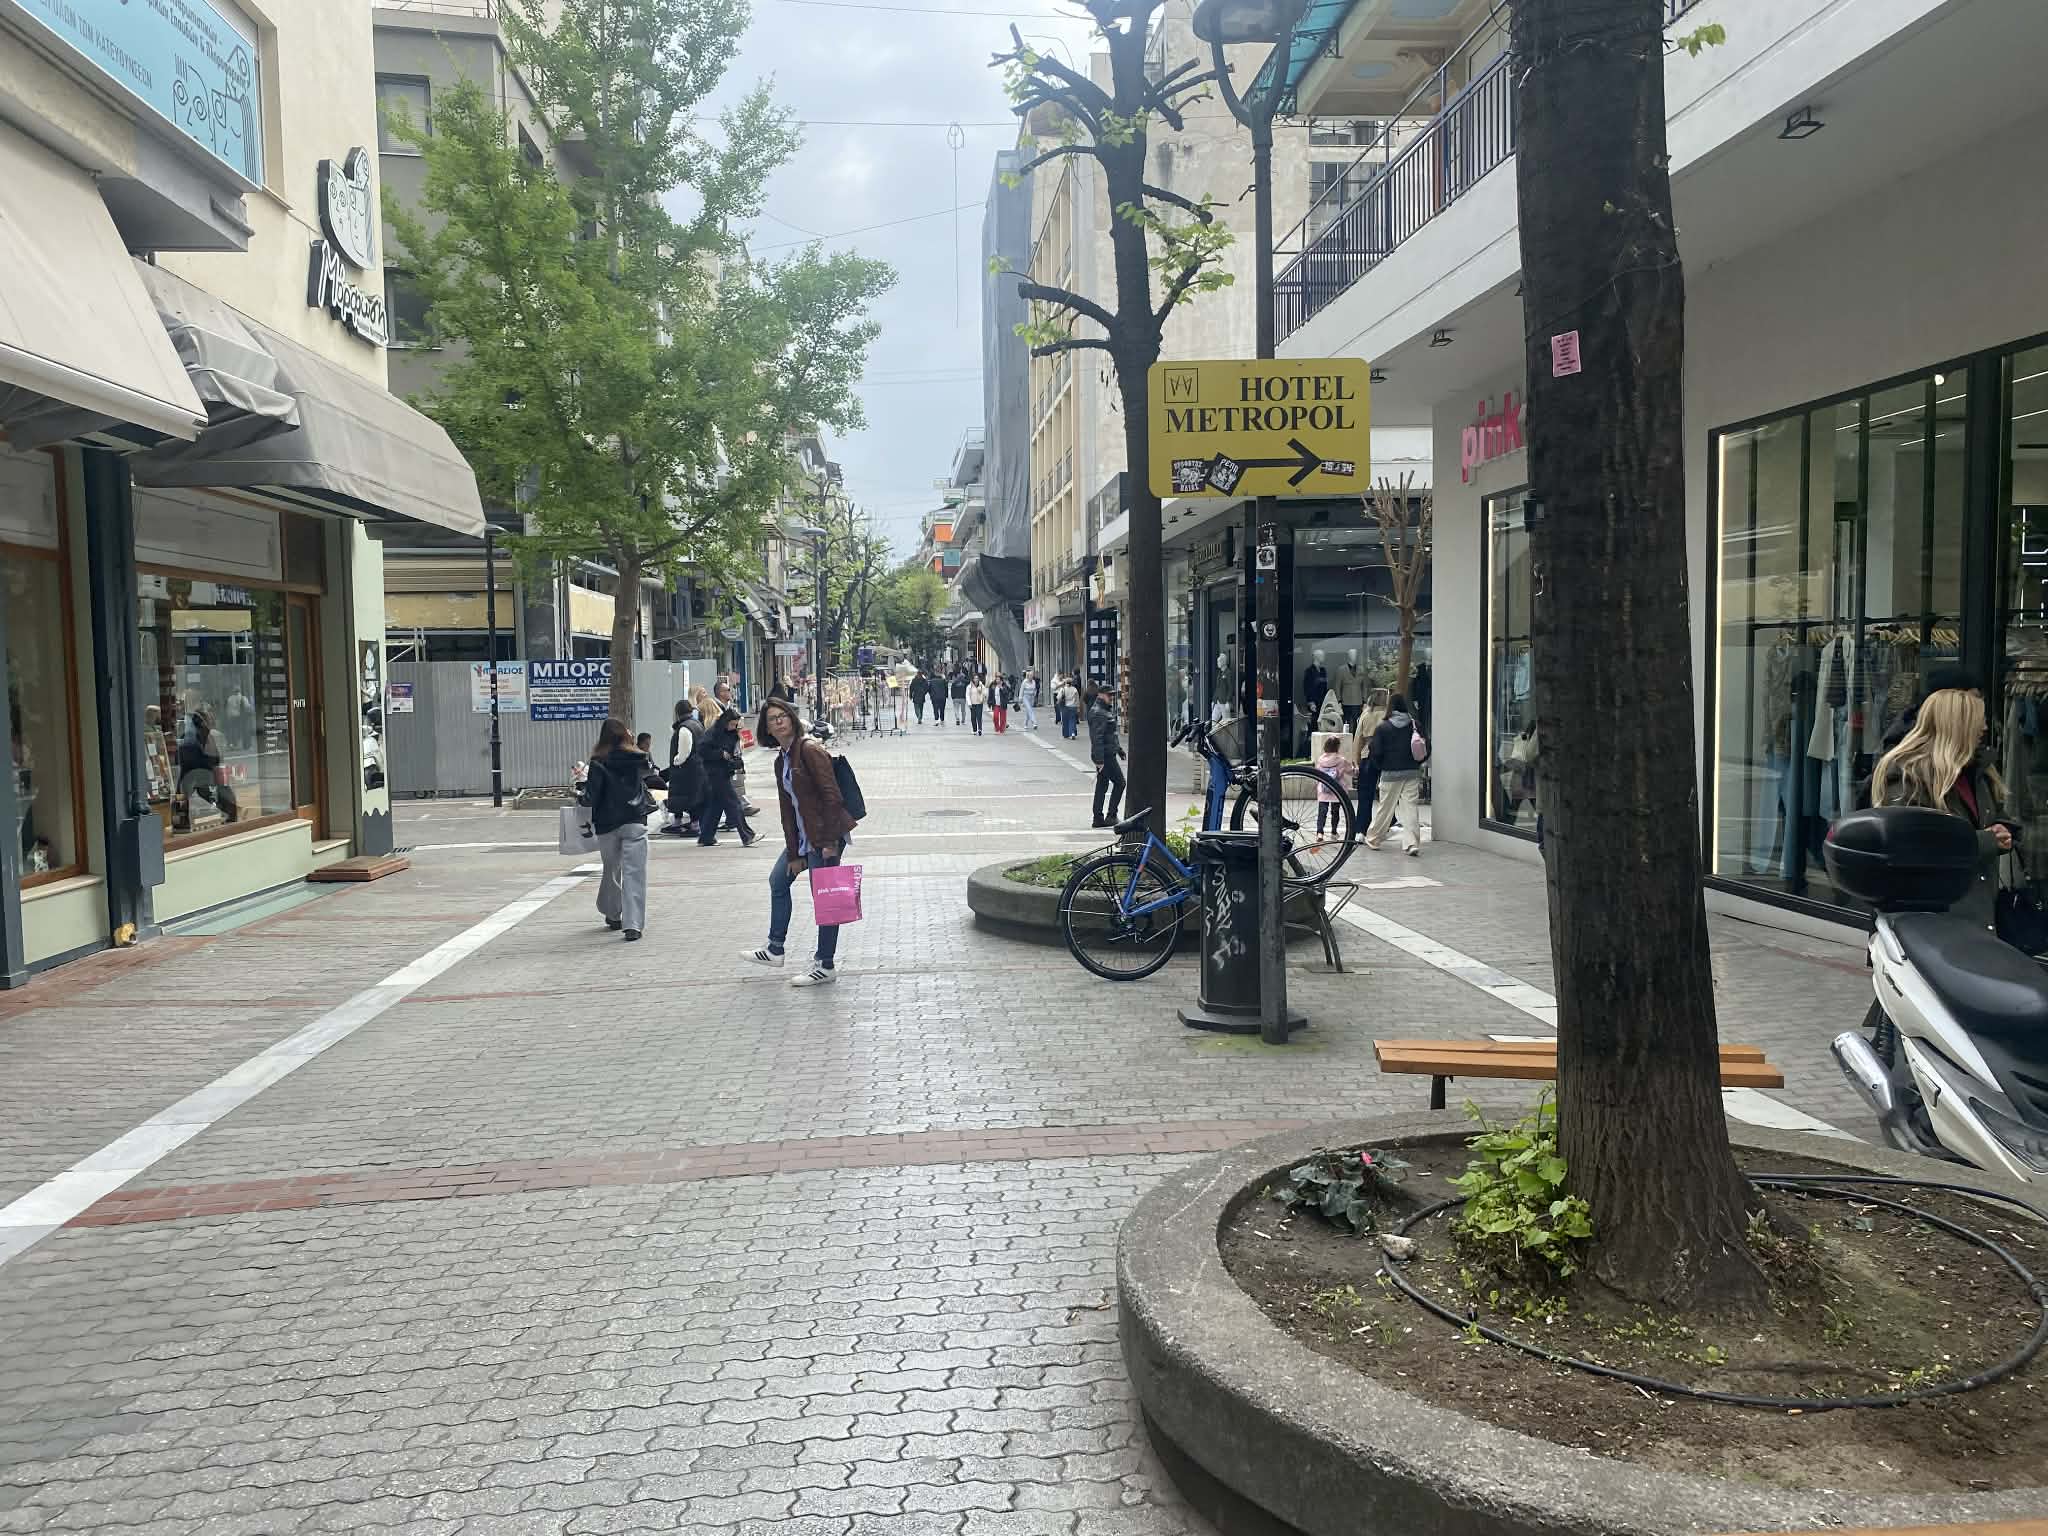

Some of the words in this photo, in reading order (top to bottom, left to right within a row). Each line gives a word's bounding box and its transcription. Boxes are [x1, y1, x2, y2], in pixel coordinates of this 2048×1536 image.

[78, 15, 94, 43] ΤΩΝ
[1239, 376, 1355, 402] HOTEL
[1164, 405, 1355, 433] METROPOL
[1461, 391, 1523, 484] pink
